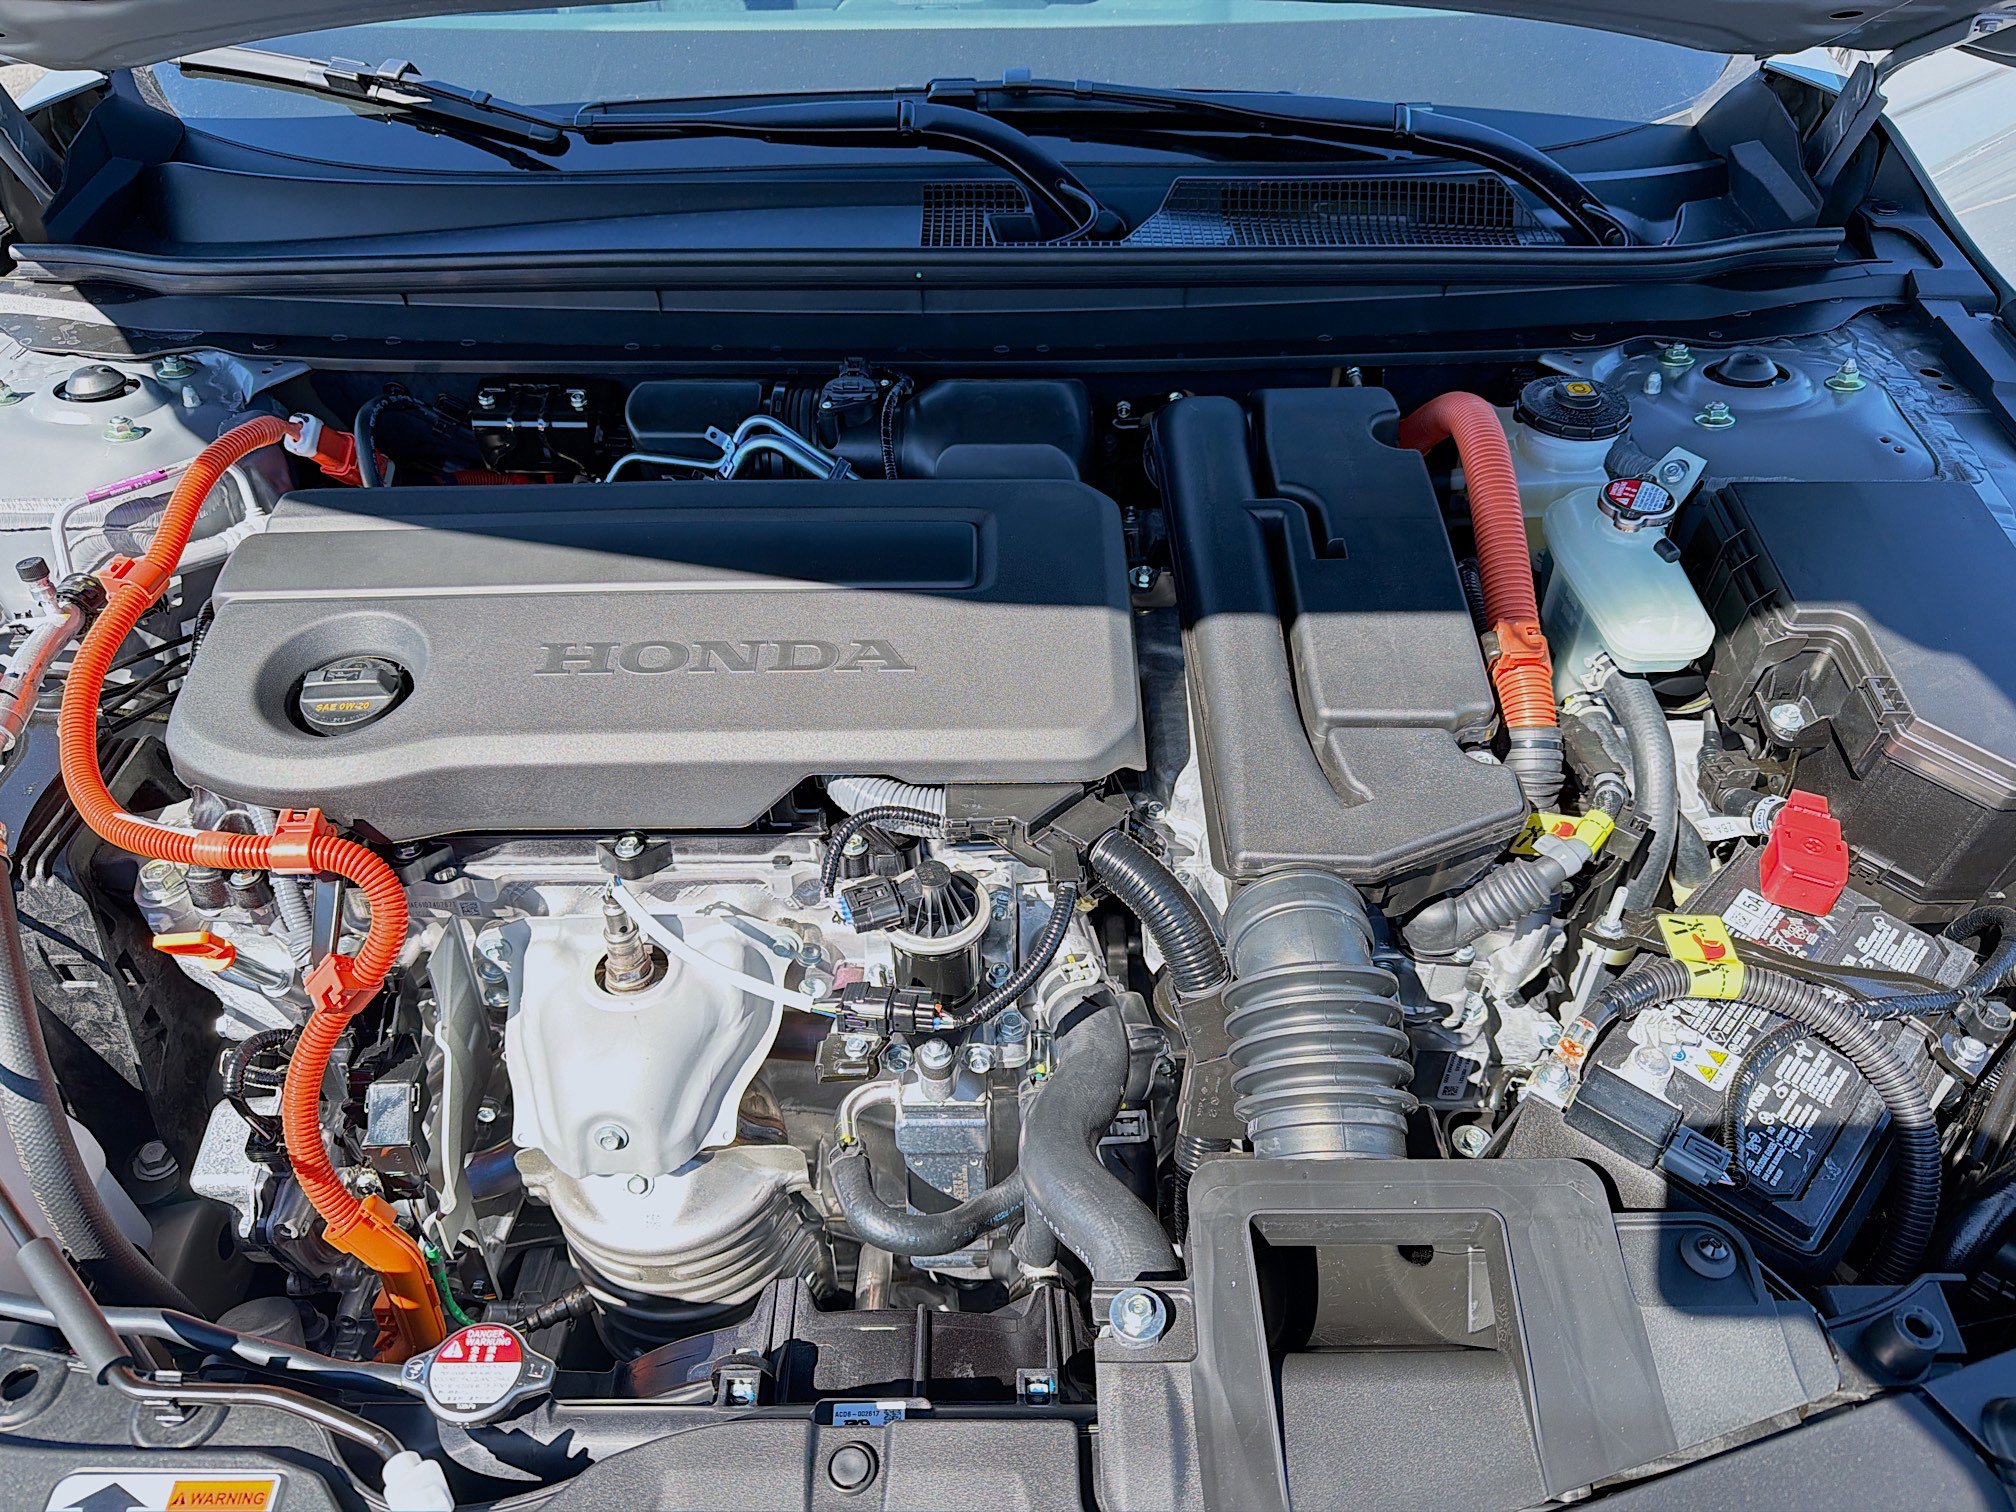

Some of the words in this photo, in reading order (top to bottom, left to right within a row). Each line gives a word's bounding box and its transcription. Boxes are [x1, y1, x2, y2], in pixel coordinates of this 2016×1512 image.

[532, 640, 916, 676] HONDA
[316, 702, 337, 712] SAE
[340, 702, 370, 711] 0W-20
[1741, 892, 1764, 914] 5A
[1747, 1082, 1771, 1112] POISON
[466, 1329, 506, 1338] DANGER
[190, 1492, 265, 1505] WARNING
